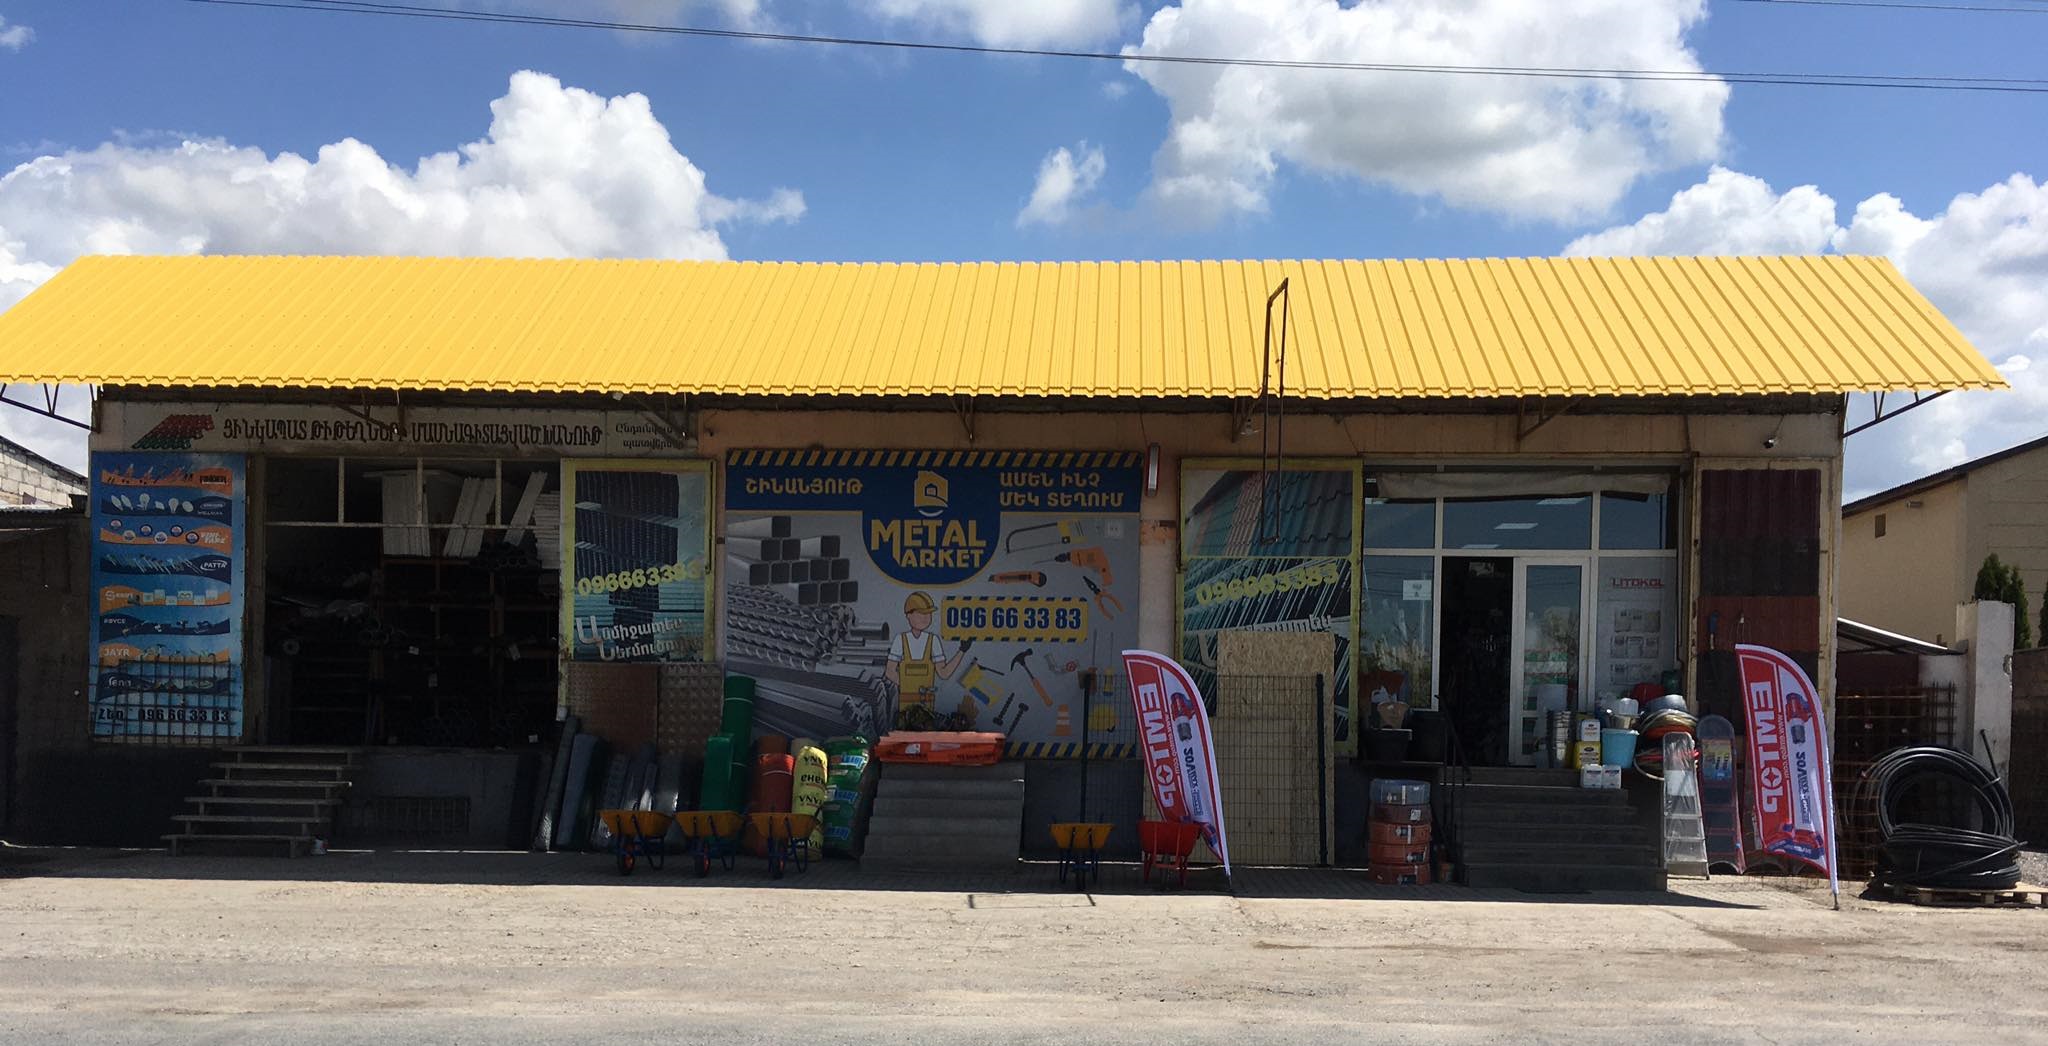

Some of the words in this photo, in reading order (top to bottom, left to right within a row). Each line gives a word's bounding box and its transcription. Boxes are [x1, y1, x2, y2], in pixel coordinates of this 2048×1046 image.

[745, 477, 863, 497] ՇԻՆԱՆՅՈՒԹ
[999, 471, 1055, 488] ԱՄԵՆ
[1060, 471, 1101, 488] ԻՆՉ
[999, 491, 1040, 508] ՄԵԿ
[1046, 491, 1124, 509] ՏԵՂՈՒՄ
[870, 518, 987, 553] METAL
[946, 605, 986, 630] 096
[991, 605, 1019, 630] 66
[1023, 605, 1051, 630] 33
[1055, 605, 1082, 630] 83
